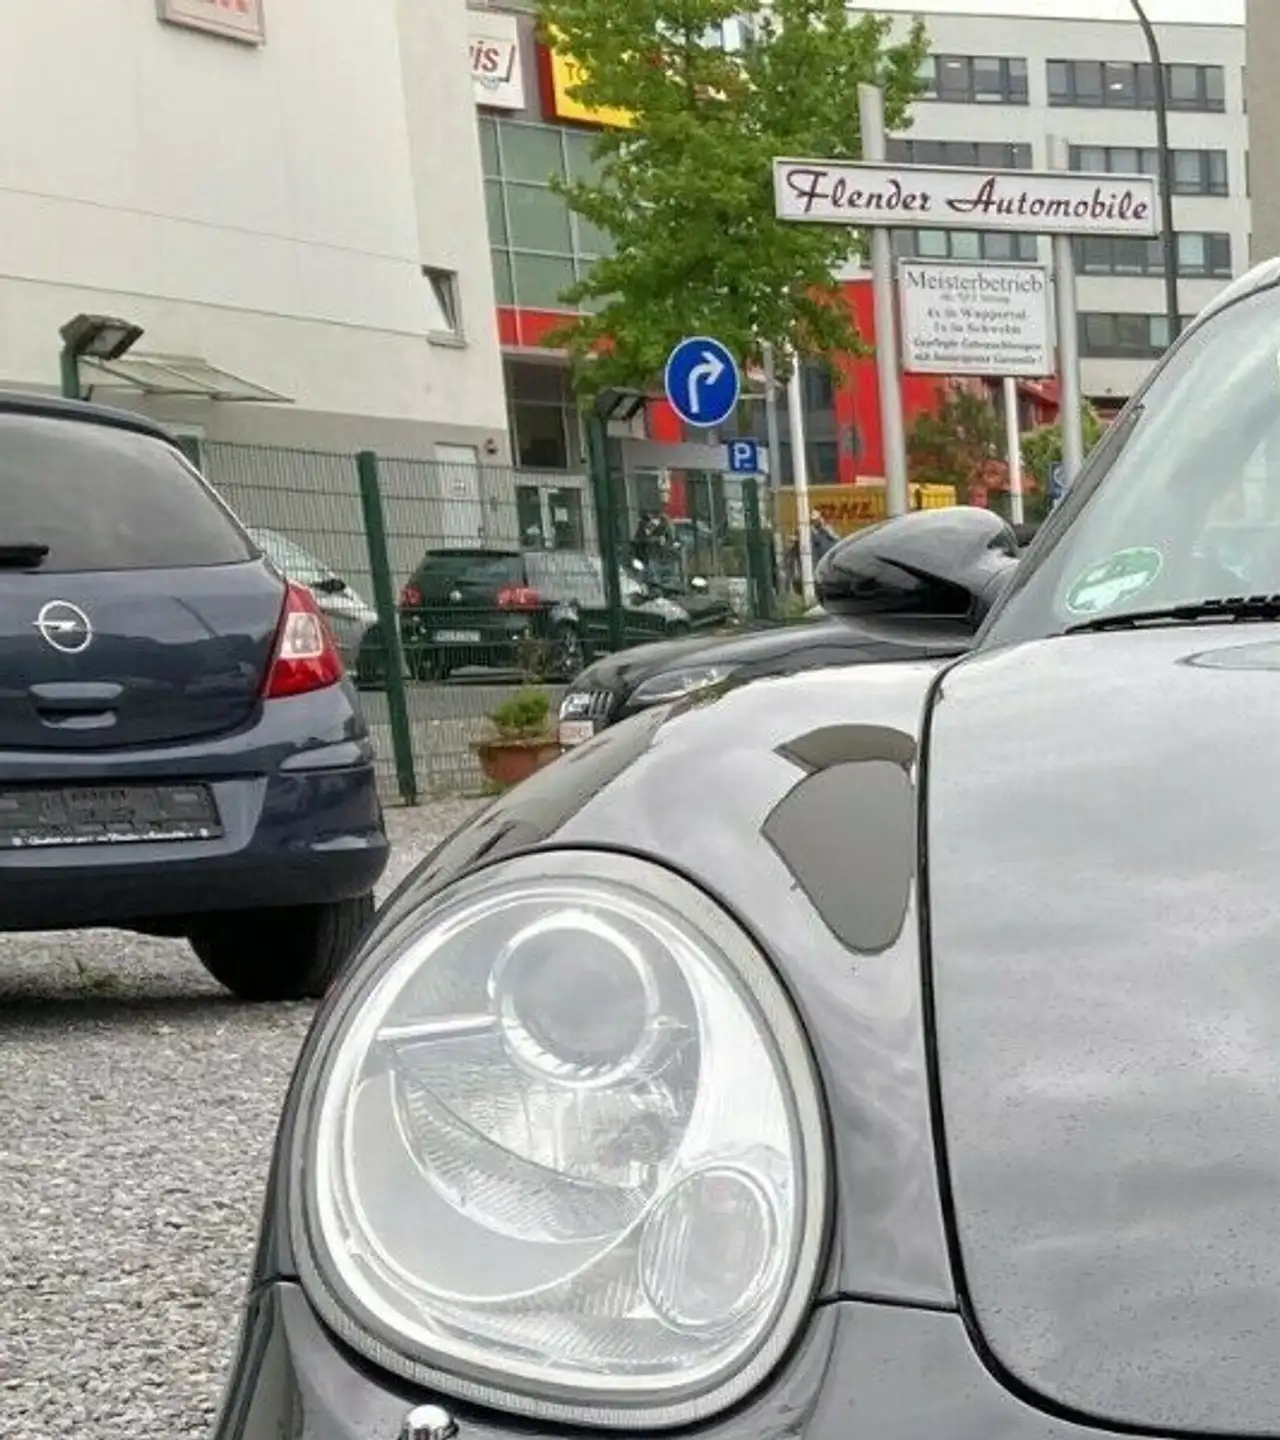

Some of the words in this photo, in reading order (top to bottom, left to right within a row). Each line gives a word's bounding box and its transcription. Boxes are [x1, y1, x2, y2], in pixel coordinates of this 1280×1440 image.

[786, 168, 933, 214] Flender
[945, 175, 1150, 221] Automobile
[906, 270, 1043, 294] Meisterbetrieb
